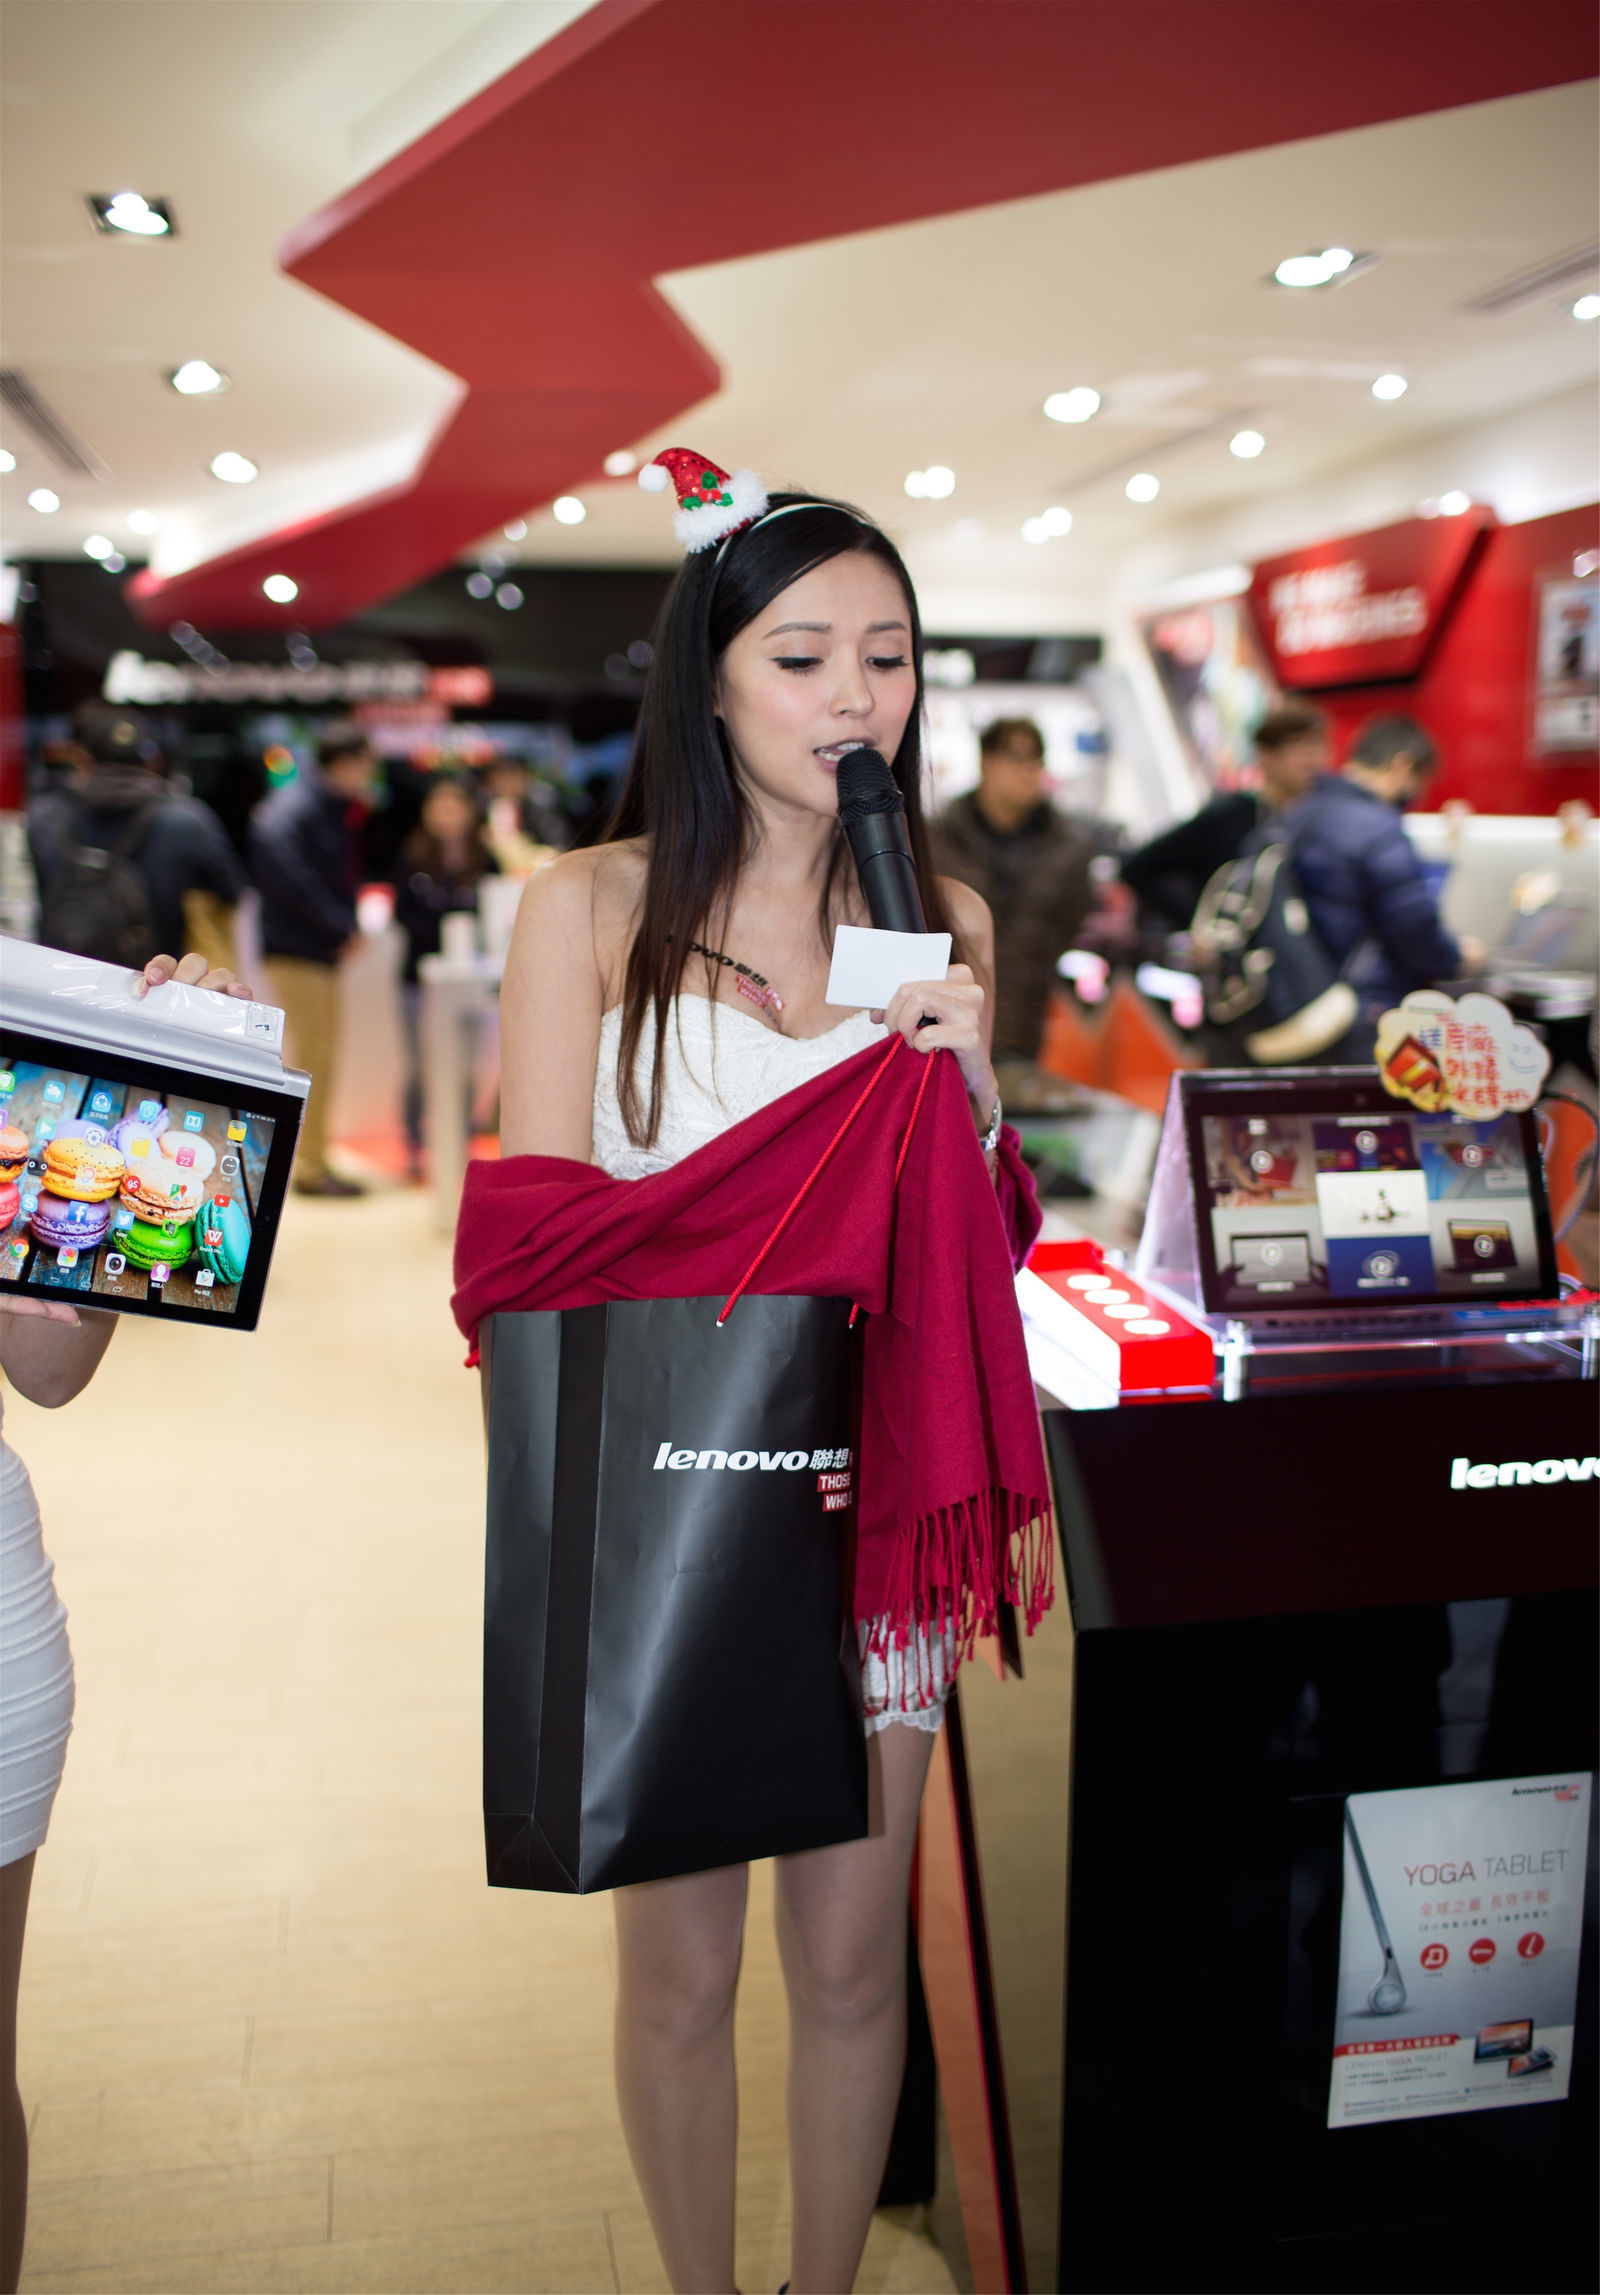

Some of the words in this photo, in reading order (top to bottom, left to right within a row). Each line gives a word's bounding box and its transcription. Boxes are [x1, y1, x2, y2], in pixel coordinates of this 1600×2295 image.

[180, 1156, 190, 1166] 22
[653, 1442, 809, 1471] lenovo
[809, 1448, 849, 1470] 聯想
[1450, 1457, 1600, 1490] lenov
[826, 1494, 847, 1509] WHO
[1403, 1861, 1476, 1886] YOGA
[1483, 1849, 1570, 1879] TABLET
